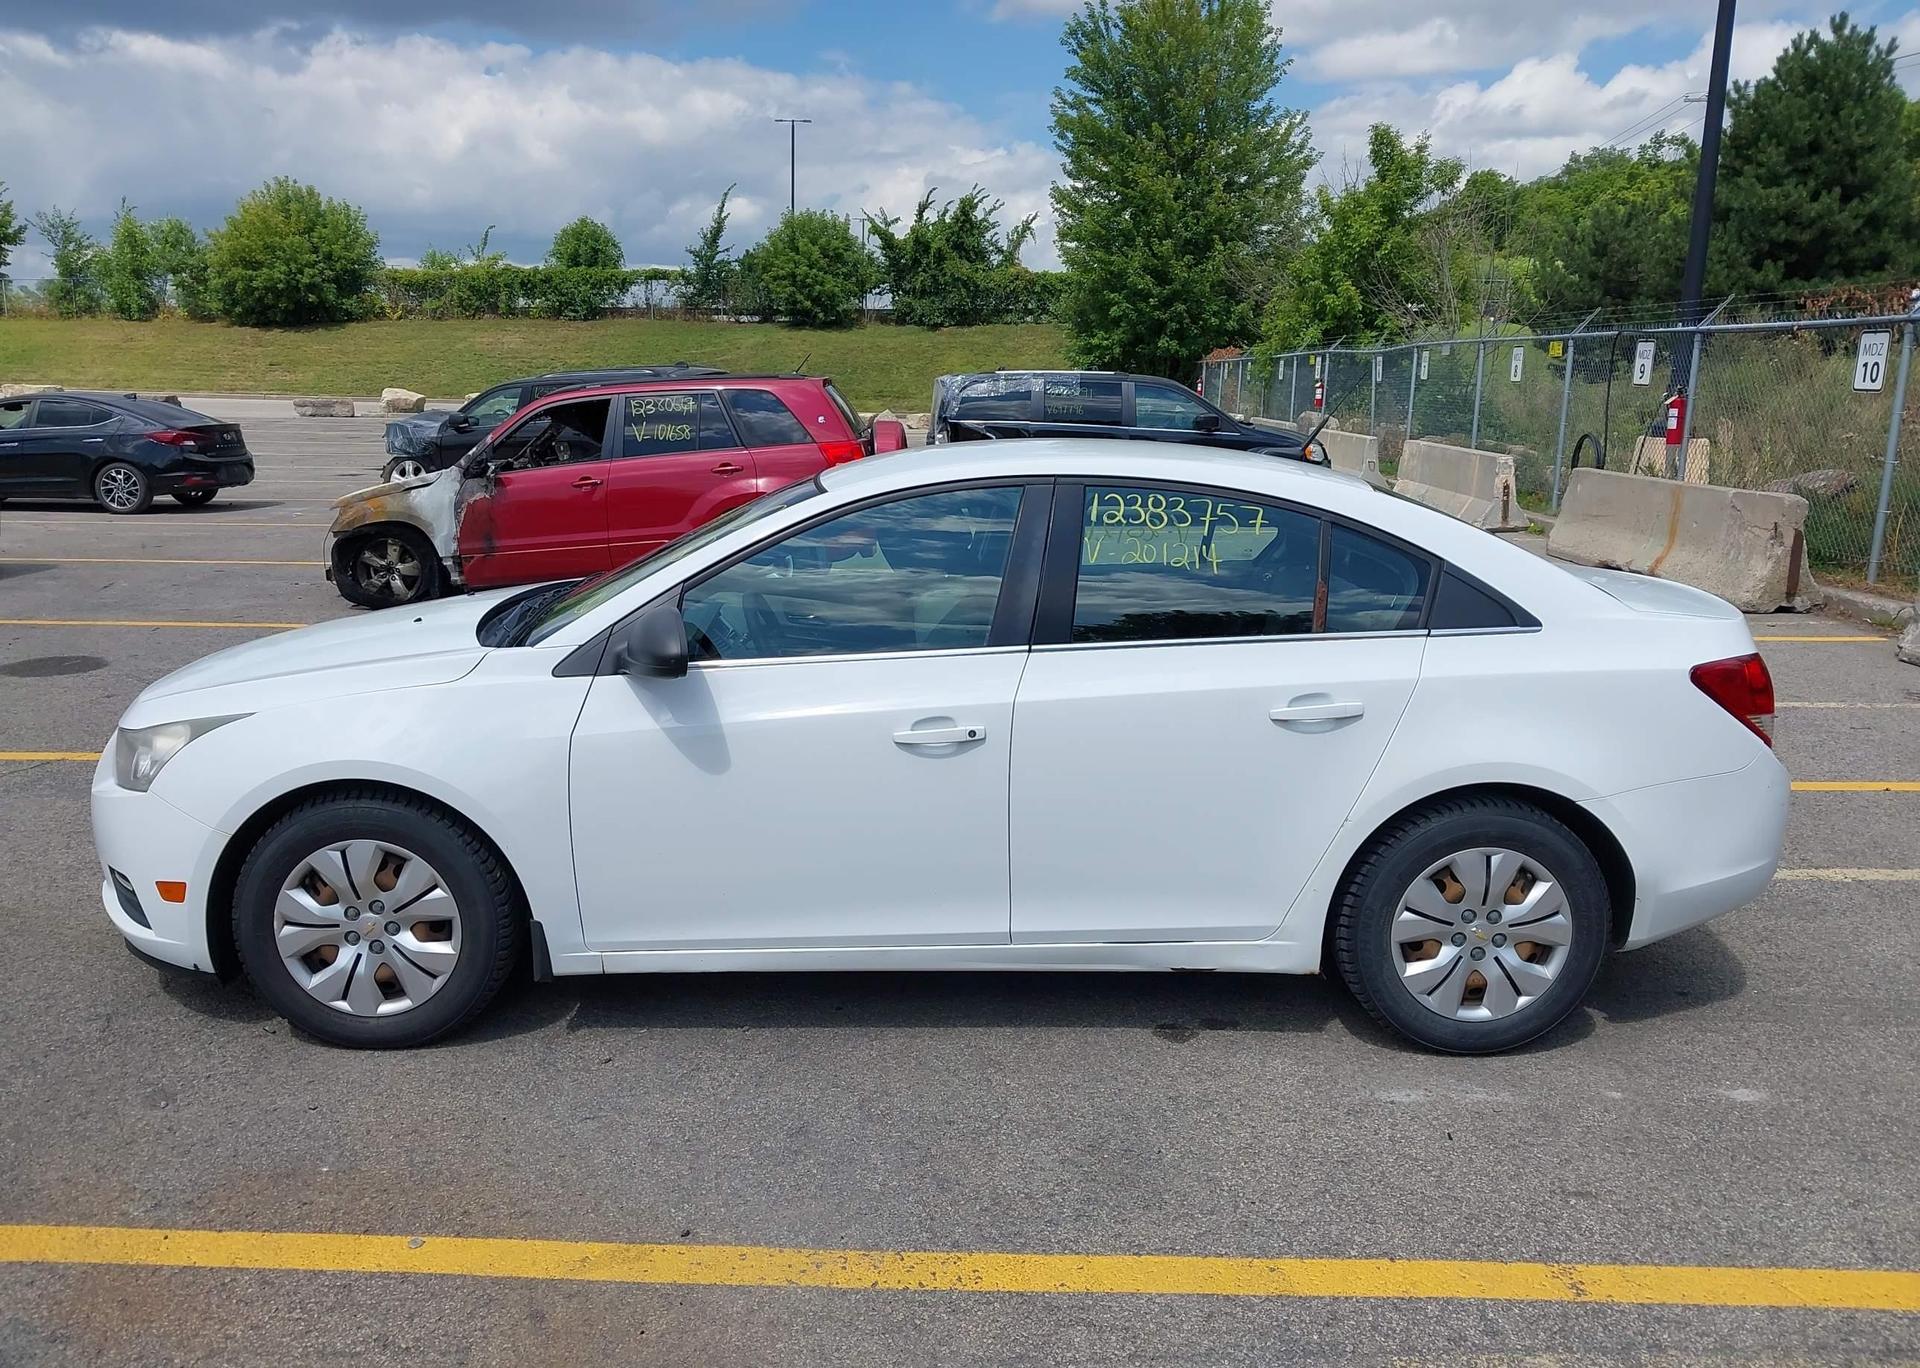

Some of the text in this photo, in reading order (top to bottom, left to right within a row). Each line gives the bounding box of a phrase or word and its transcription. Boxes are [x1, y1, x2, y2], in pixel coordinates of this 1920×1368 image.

[1639, 349, 1652, 360] MDZ
[1862, 342, 1885, 357] MDZ
[1513, 364, 1519, 378] 8
[1639, 363, 1646, 380] 9
[1862, 361, 1880, 384] 10
[1090, 493, 1270, 537] 12383757
